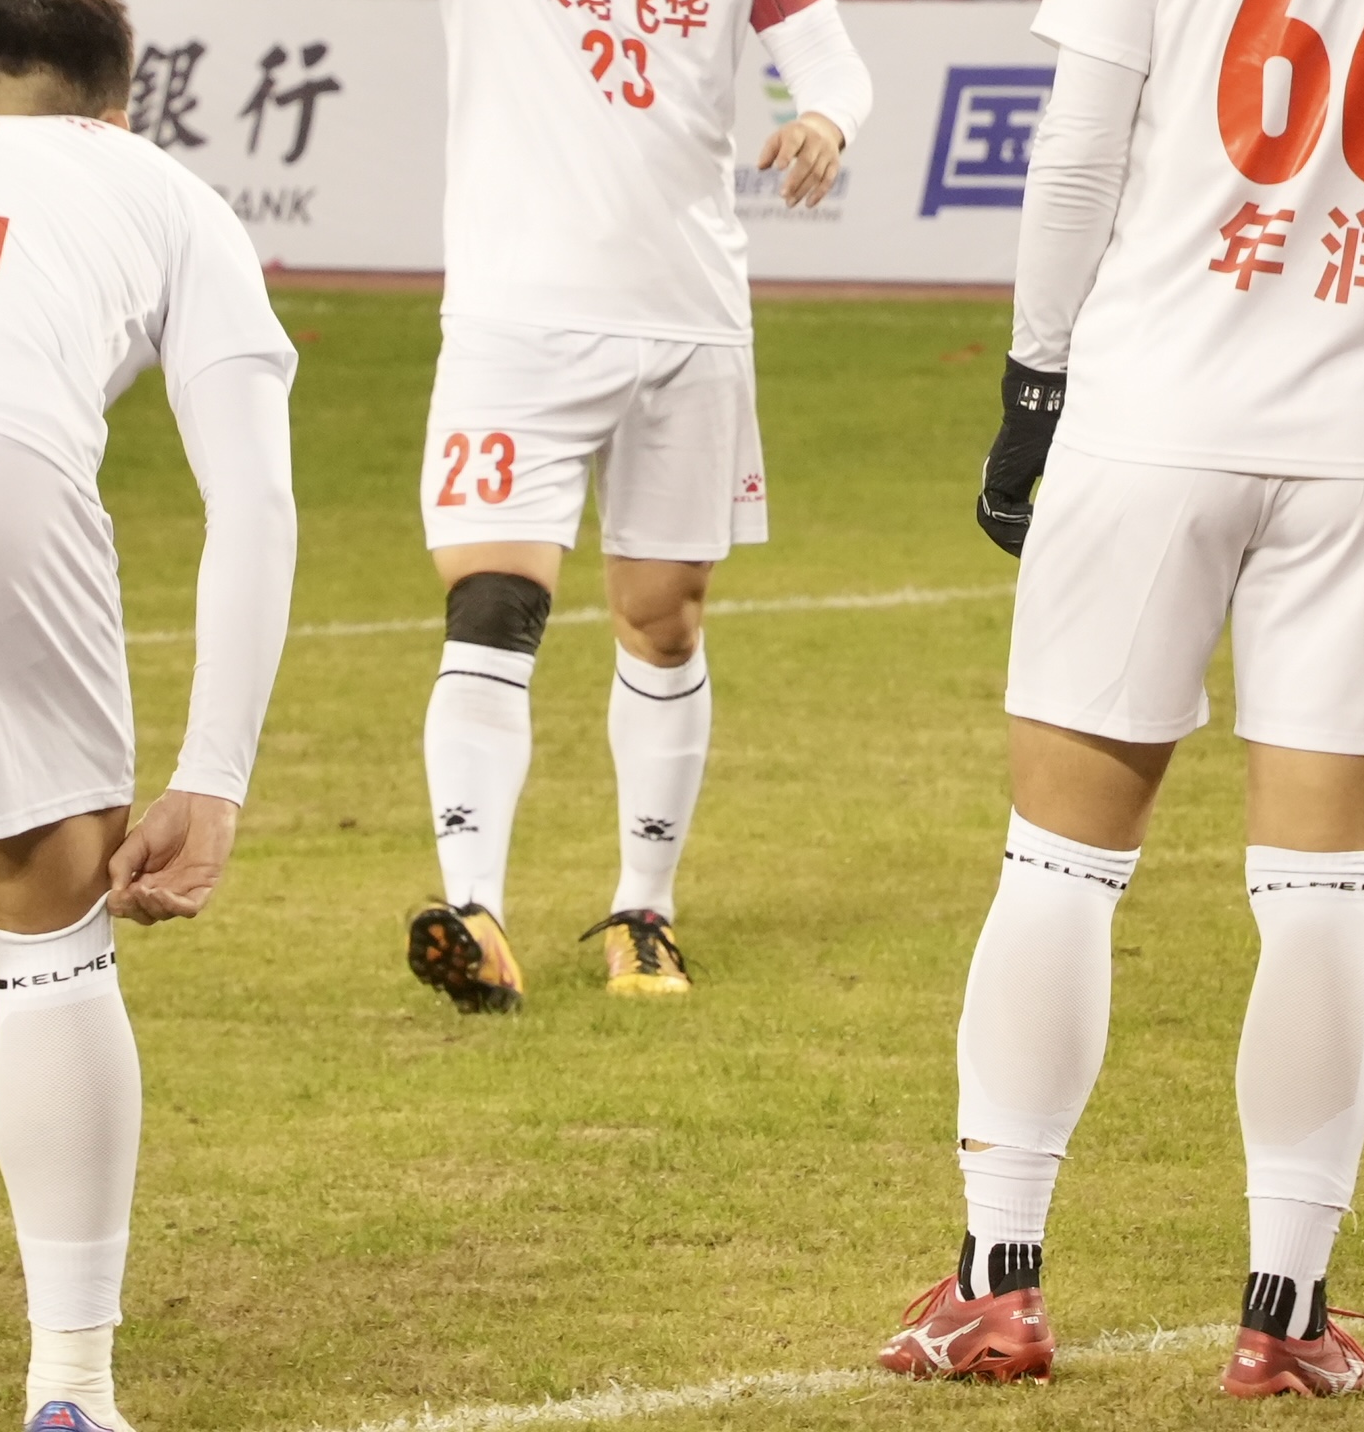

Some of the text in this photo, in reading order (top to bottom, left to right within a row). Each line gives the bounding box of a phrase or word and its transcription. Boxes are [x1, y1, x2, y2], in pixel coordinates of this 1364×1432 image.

[581, 29, 655, 109] 23
[436, 432, 517, 507] 23
[11, 953, 109, 990] KELME
